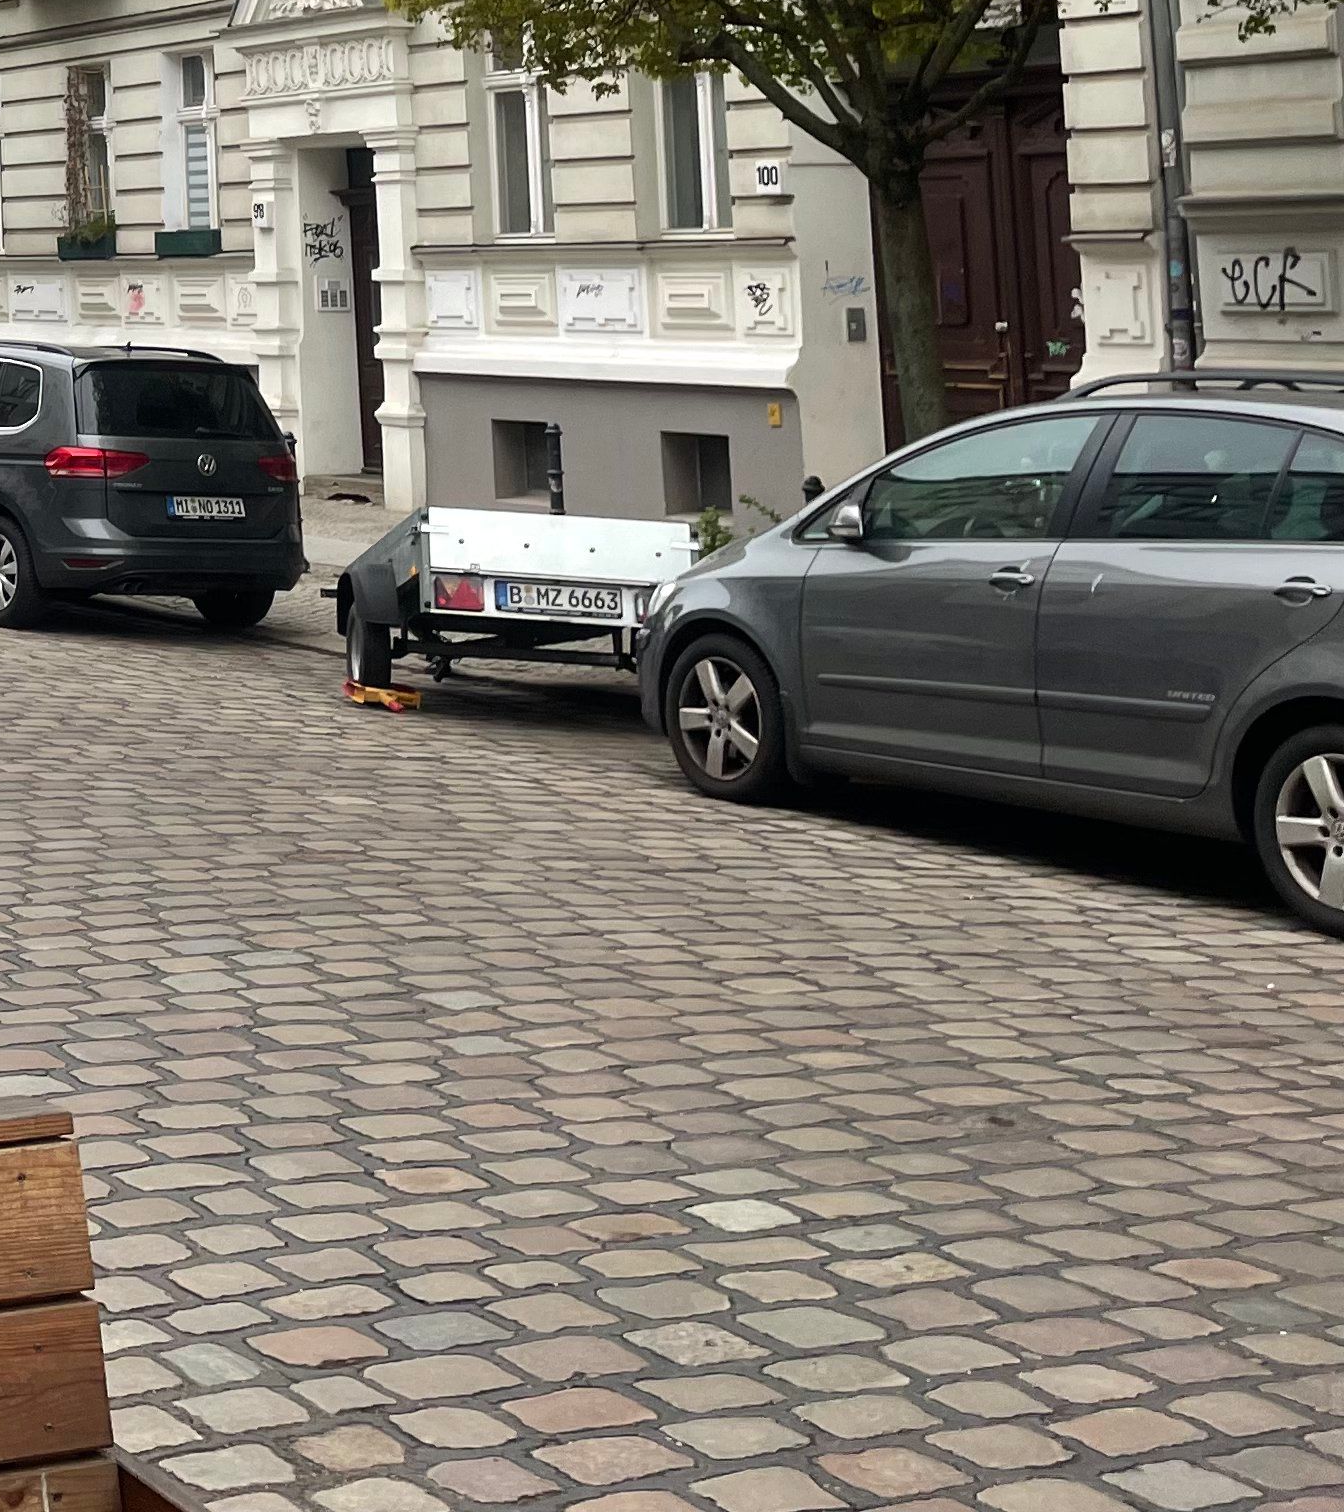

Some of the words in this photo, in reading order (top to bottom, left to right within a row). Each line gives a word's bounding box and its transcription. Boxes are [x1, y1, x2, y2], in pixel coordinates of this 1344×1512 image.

[757, 166, 779, 186] 100
[253, 203, 265, 219] 98
[215, 499, 243, 515] 1311
[510, 585, 522, 604] B
[536, 587, 564, 607] MZ
[568, 589, 618, 611] 6663
